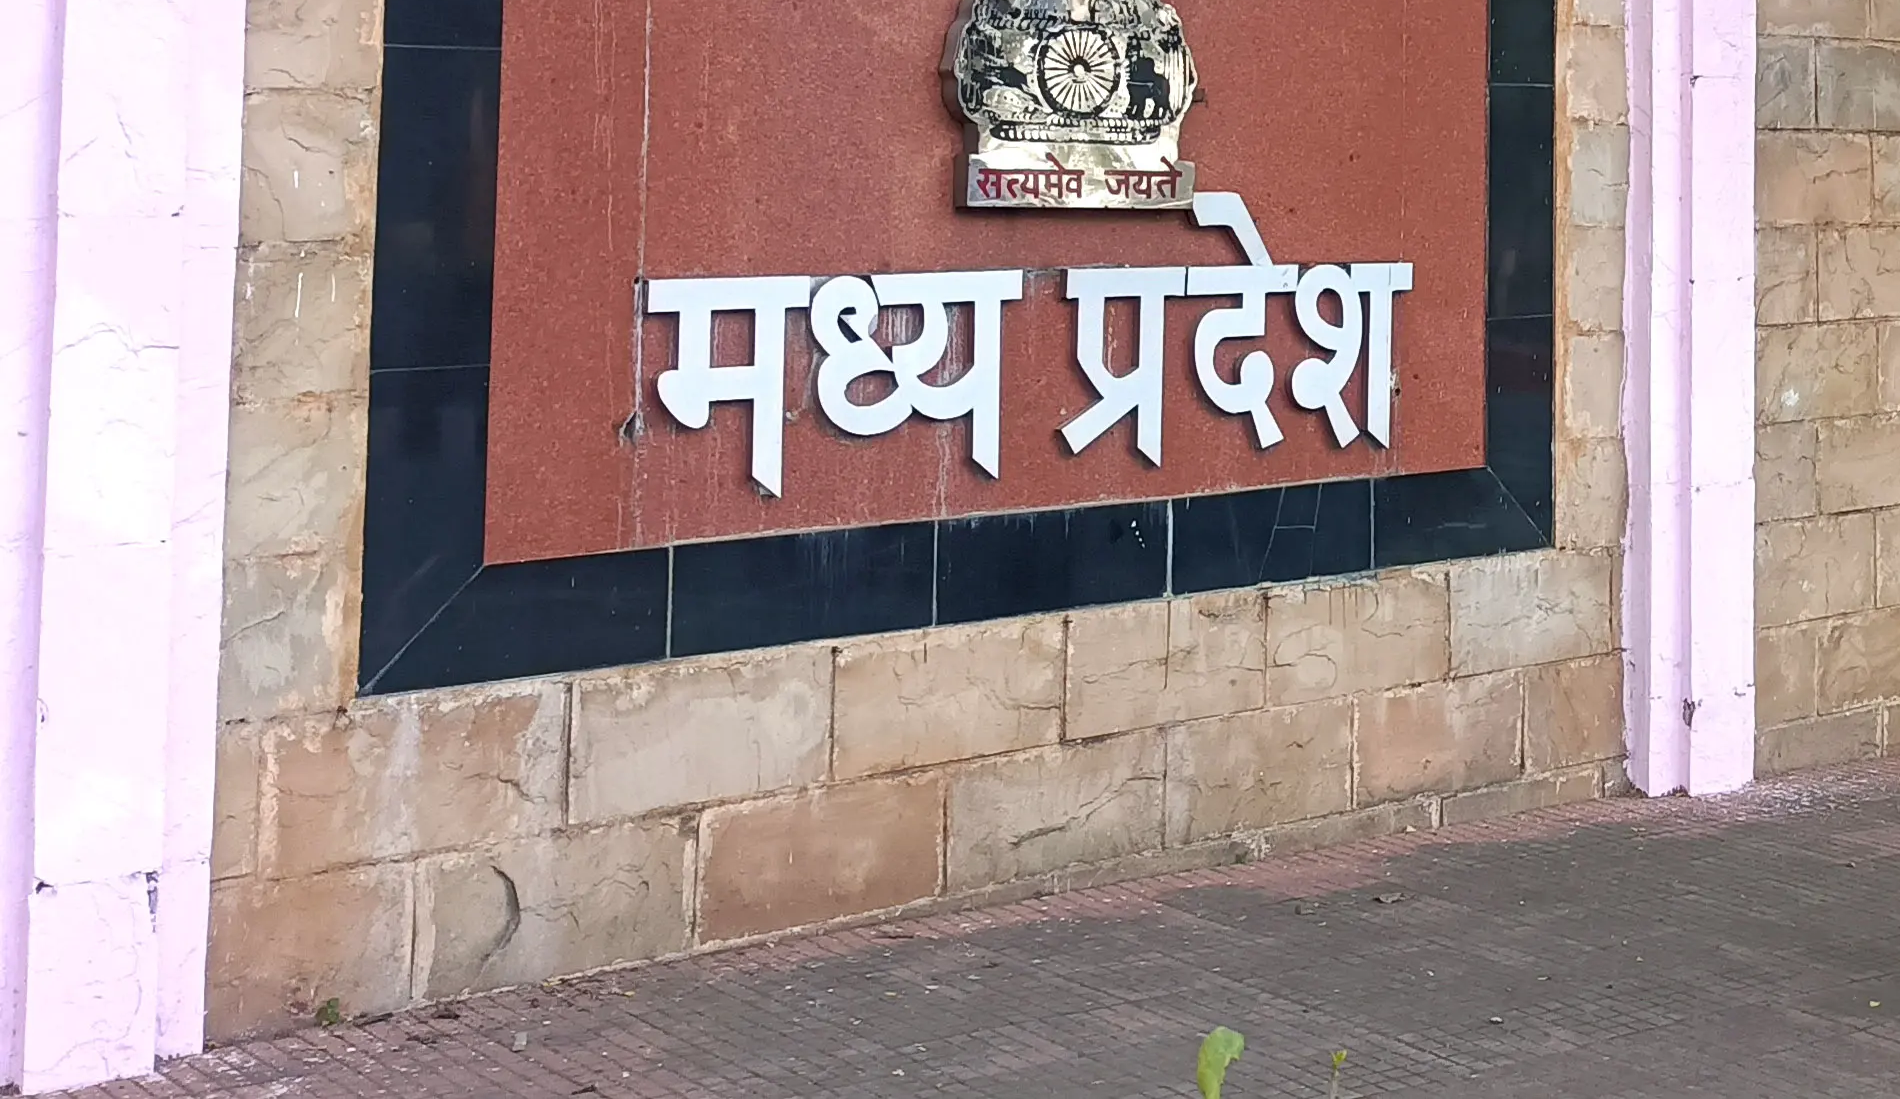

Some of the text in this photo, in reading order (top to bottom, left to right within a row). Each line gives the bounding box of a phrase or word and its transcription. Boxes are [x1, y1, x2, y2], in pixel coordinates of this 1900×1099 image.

[976, 152, 1183, 198] सत्यमेव जयते
[647, 191, 1414, 498] मध्य प्रदेश
